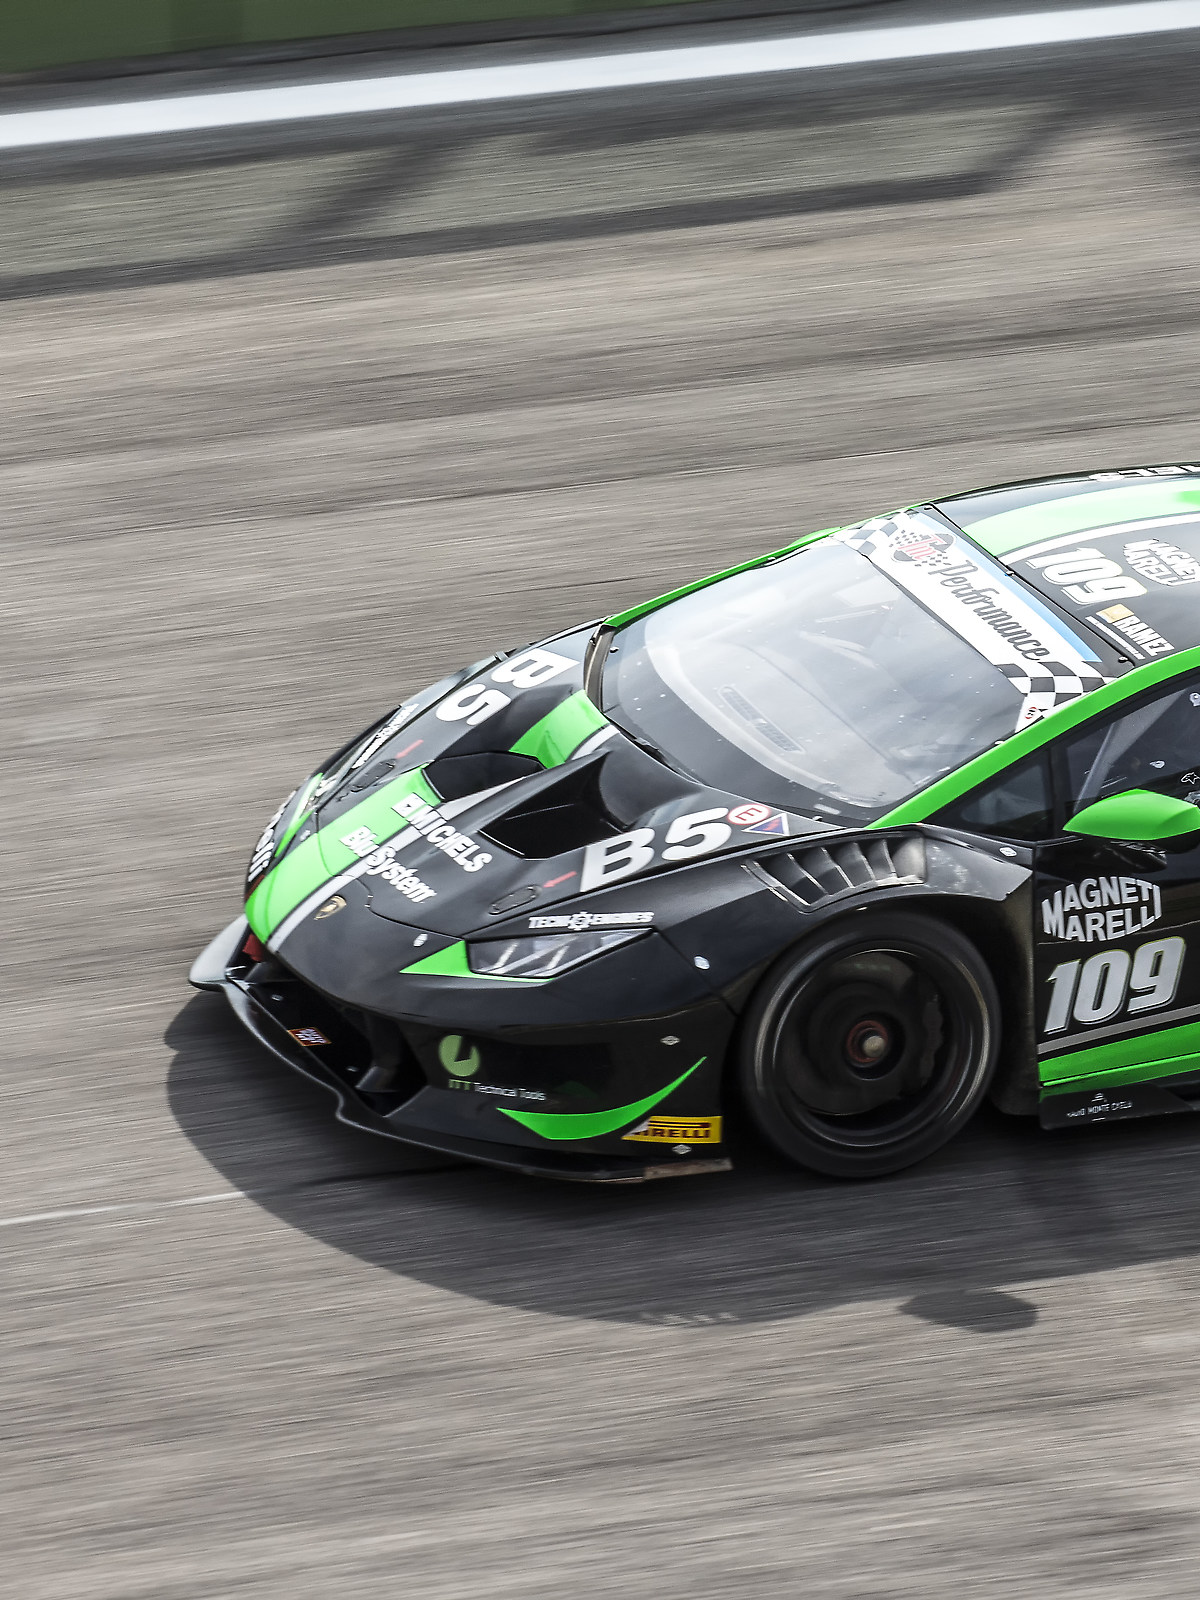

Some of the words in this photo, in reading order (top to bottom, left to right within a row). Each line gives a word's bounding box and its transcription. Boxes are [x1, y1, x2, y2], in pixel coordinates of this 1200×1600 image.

[927, 560, 1050, 661] Performance
[1025, 548, 1148, 605] 109
[436, 648, 580, 726] B5
[340, 825, 380, 858] Blu
[365, 845, 438, 904] System
[406, 805, 493, 873] MICHELS
[580, 807, 732, 893] B5
[1042, 876, 1162, 936] MAGNETI
[1042, 893, 1162, 942] MARELLI
[1044, 936, 1187, 1034] 109
[633, 1121, 711, 1138] IRELLI
